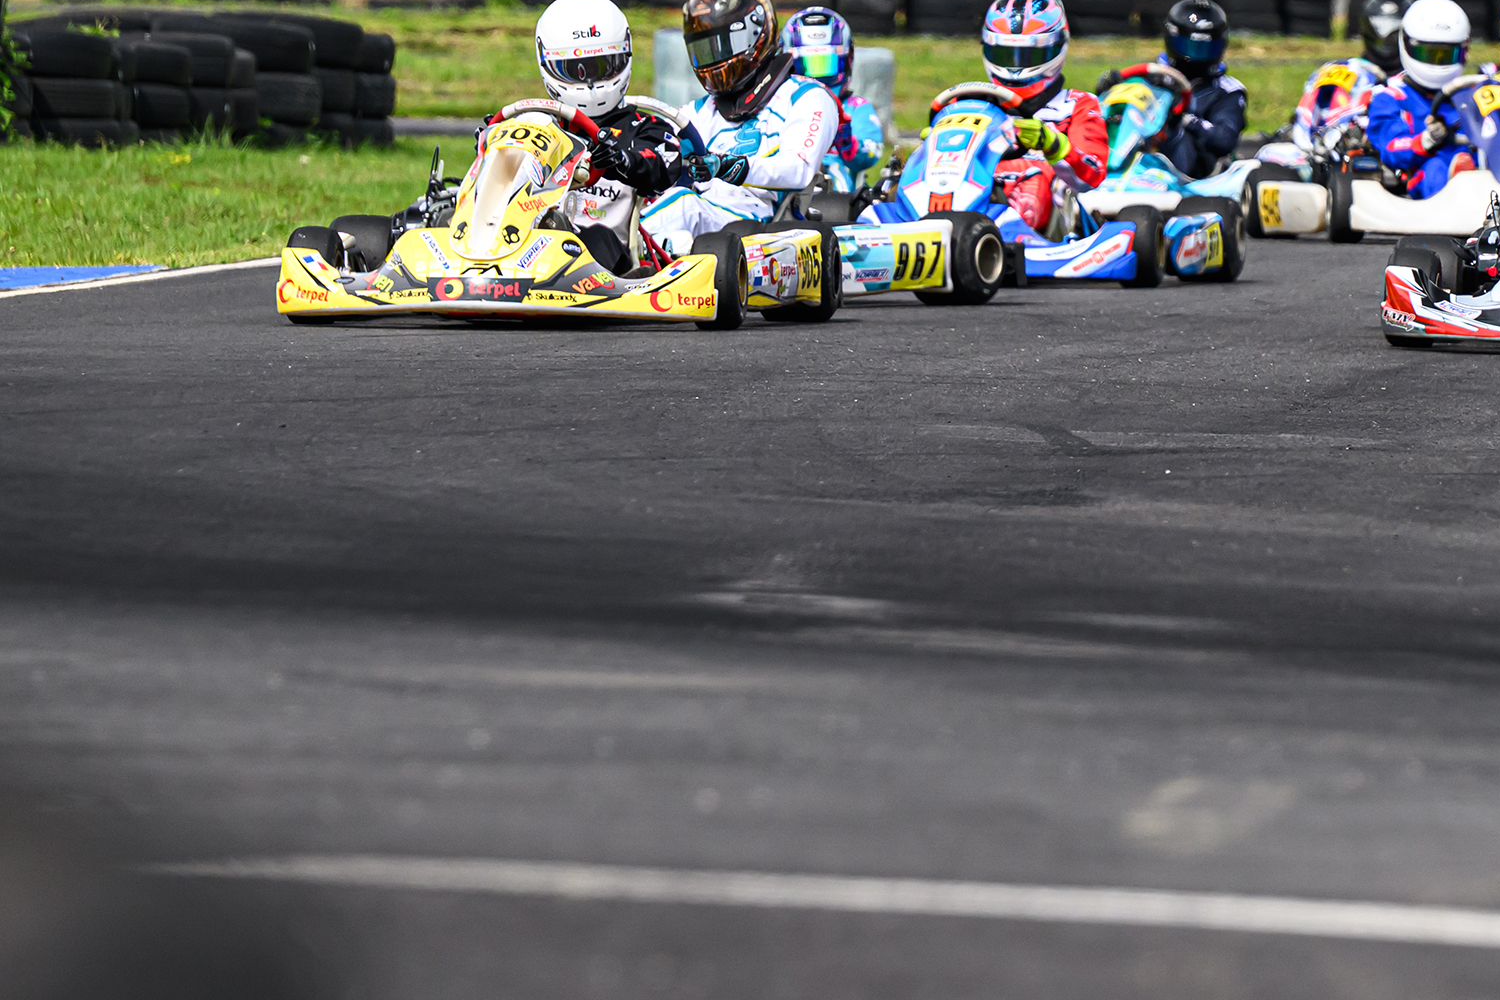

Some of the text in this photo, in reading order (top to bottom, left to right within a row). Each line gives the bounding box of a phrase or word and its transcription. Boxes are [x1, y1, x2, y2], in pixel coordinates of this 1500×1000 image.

[572, 26, 601, 39] Stilo
[583, 47, 603, 56] terpel
[491, 127, 552, 151] 905
[517, 196, 547, 212] terpel
[893, 240, 942, 281] 967
[296, 285, 328, 303] terpel
[468, 281, 521, 299] terpel
[678, 293, 716, 309] terpel
